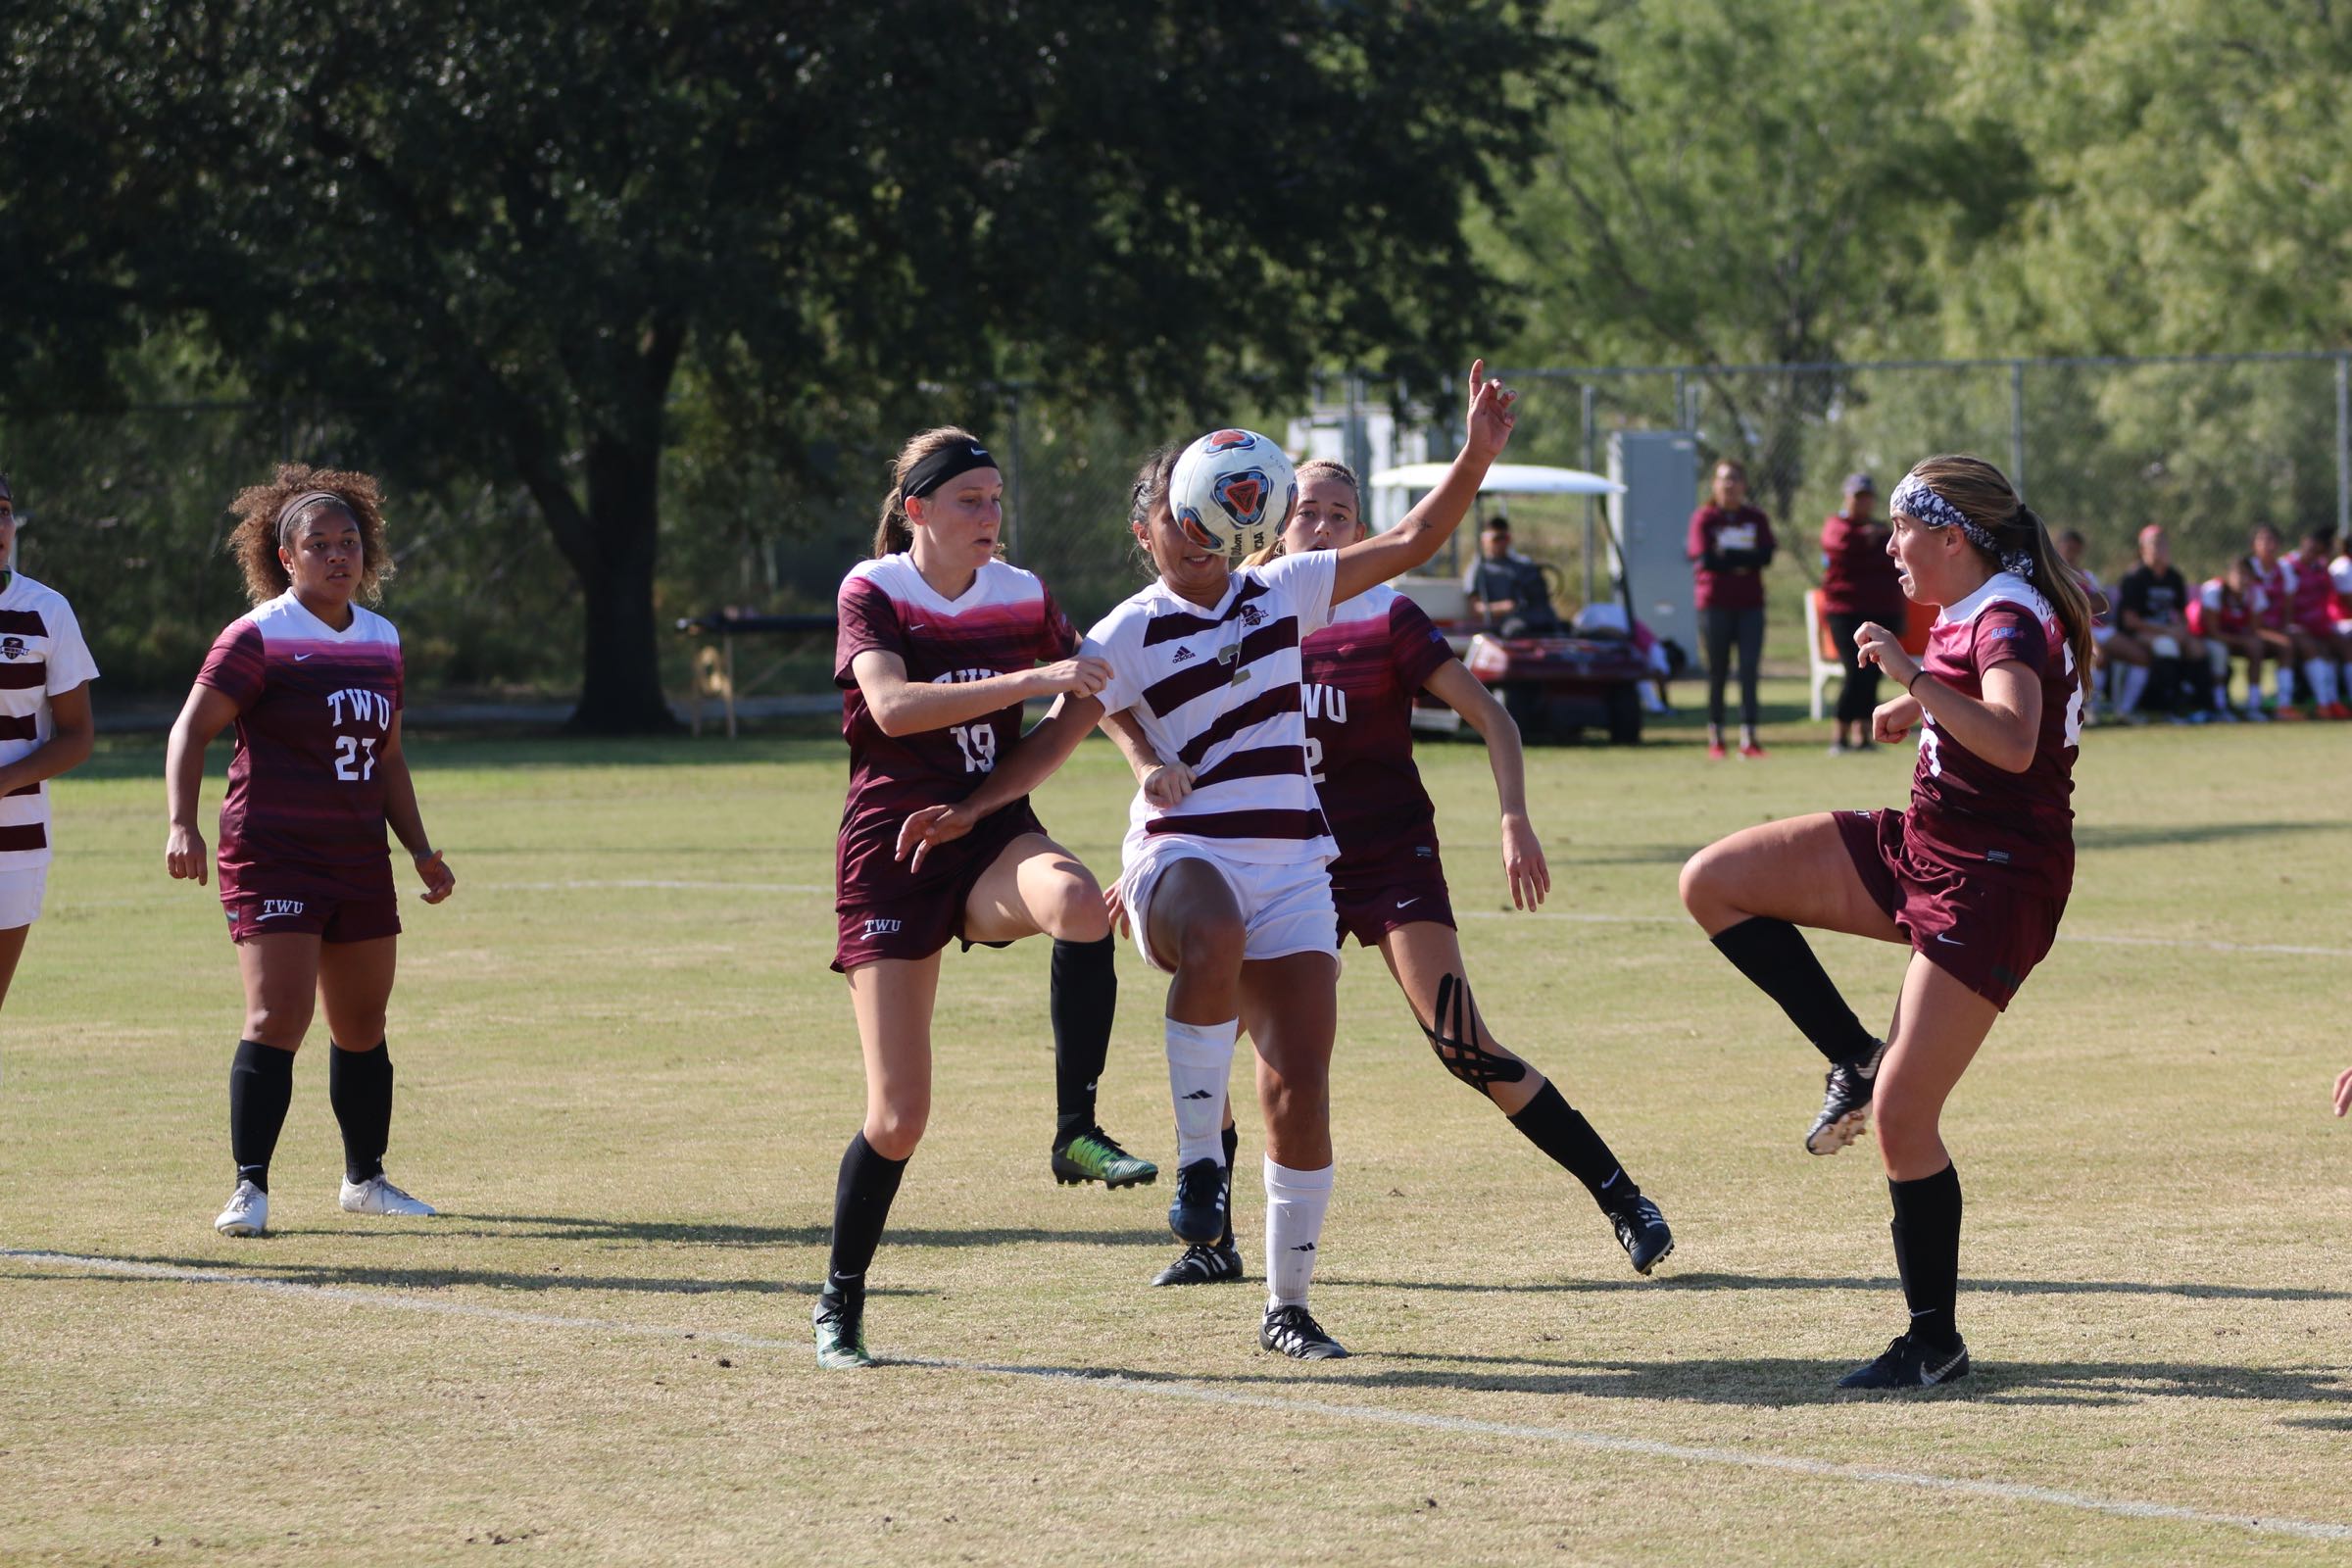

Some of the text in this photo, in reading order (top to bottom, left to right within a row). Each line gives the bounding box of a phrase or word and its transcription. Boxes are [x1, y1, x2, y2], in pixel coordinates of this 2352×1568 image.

[1230, 533, 1243, 556] ilson
[1253, 531, 1264, 550] CAA
[1172, 652, 1197, 663] adidas
[326, 688, 390, 732] TWU
[1301, 683, 1348, 724] WU
[950, 723, 996, 772] 19
[263, 899, 304, 914] TWU
[864, 918, 903, 933] TWU
